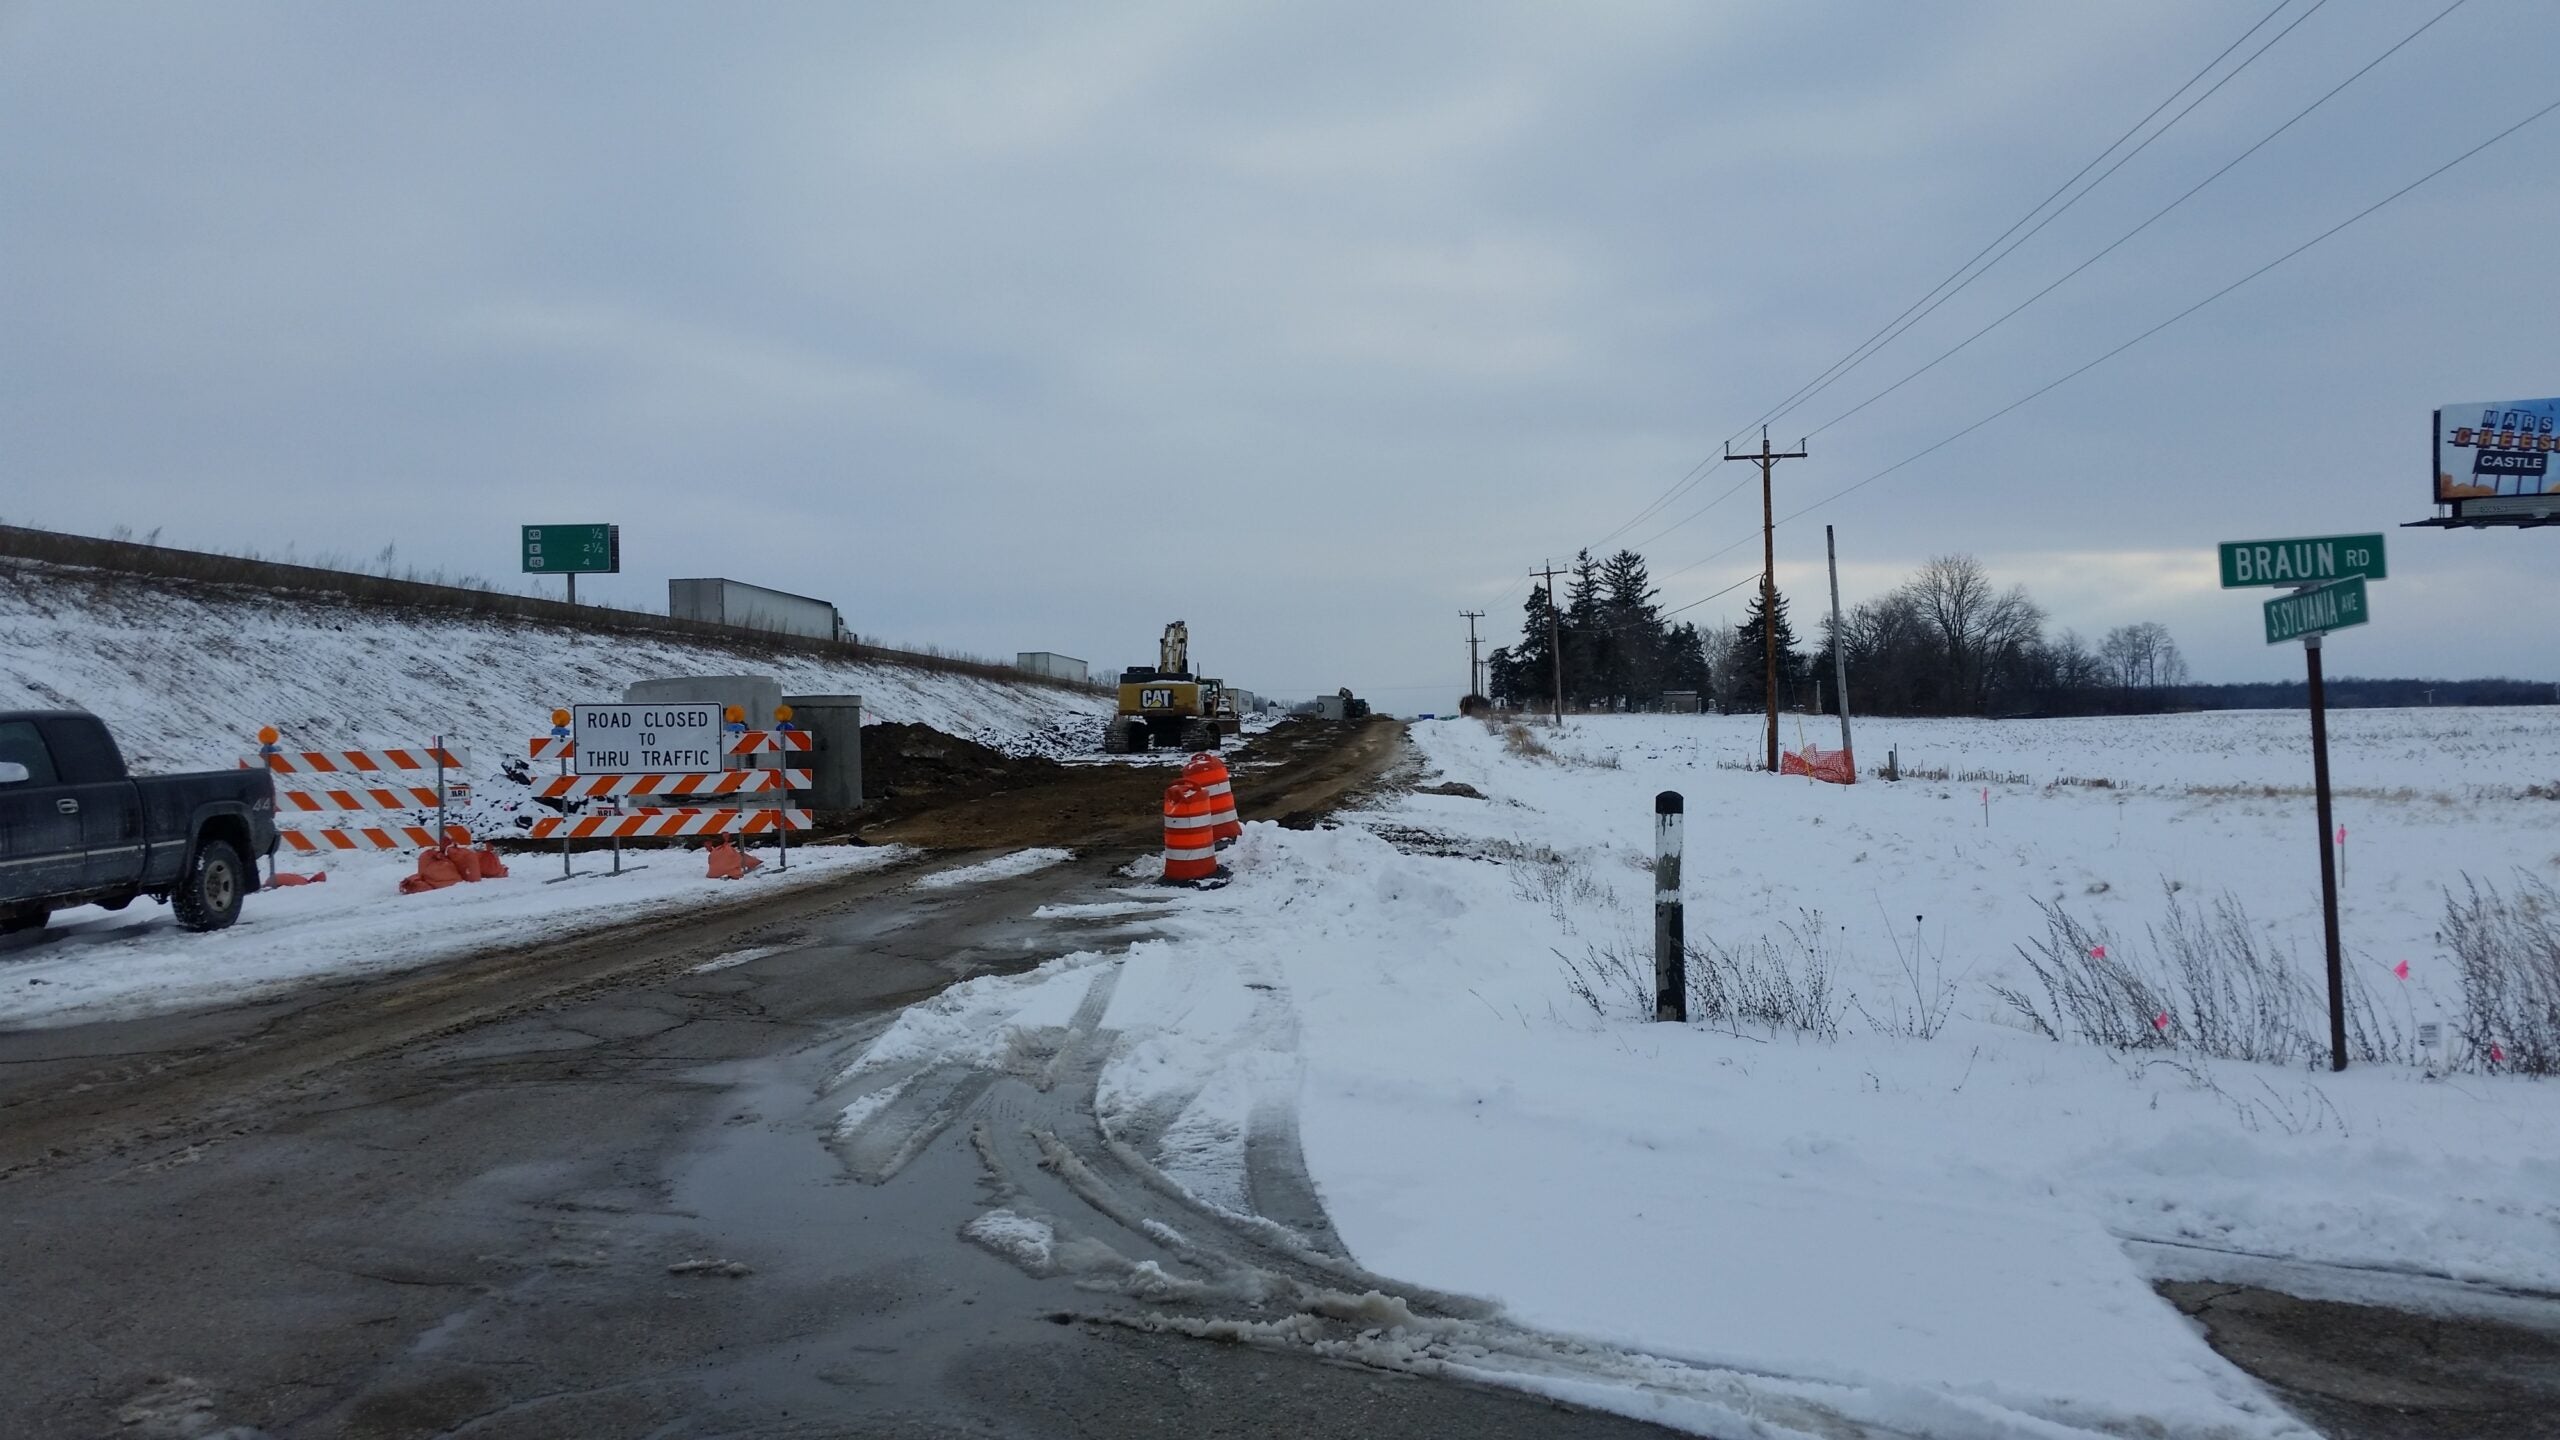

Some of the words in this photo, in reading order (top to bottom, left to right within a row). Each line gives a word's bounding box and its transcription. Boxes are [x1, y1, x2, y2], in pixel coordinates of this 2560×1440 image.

[2482, 410, 2552, 430] MARS
[2481, 455, 2543, 469] CASTLE
[2235, 542, 2336, 581] BRAUN
[2346, 549, 2370, 567] RD
[2271, 605, 2280, 638] S
[2281, 590, 2339, 636] SYLVANIA
[2342, 592, 2358, 613] AVE
[1142, 689, 1171, 708] CAT
[588, 712, 631, 728] ROAD
[644, 711, 708, 728] CLOSED
[639, 733, 656, 746] TO
[587, 751, 629, 767] THRU
[642, 750, 709, 767] TRAFFIC
